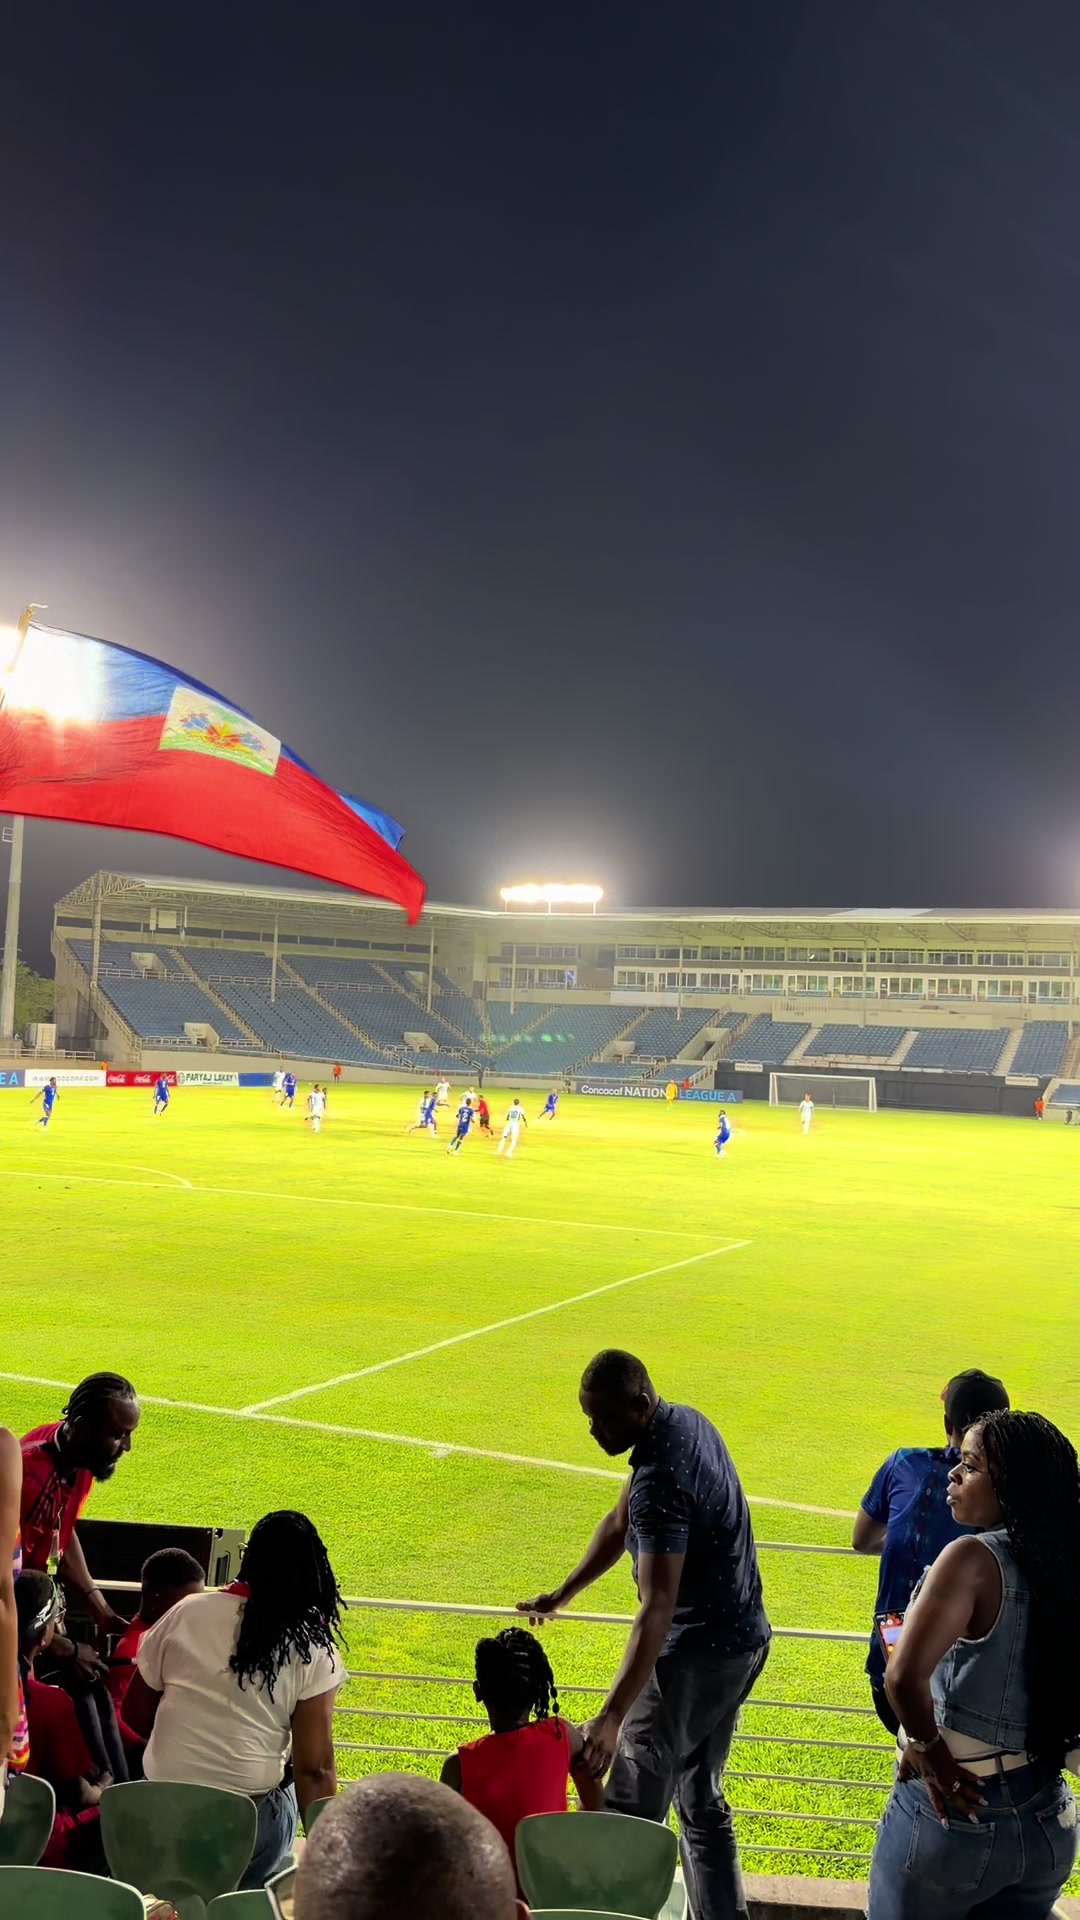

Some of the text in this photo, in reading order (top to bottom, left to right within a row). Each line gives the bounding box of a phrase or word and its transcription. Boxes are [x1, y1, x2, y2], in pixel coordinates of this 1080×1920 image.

[186, 1073, 212, 1081] PARYAJ
[581, 1085, 736, 1102] Concacaf NATION LEAGUE A
[462, 1112, 468, 1122] 2
